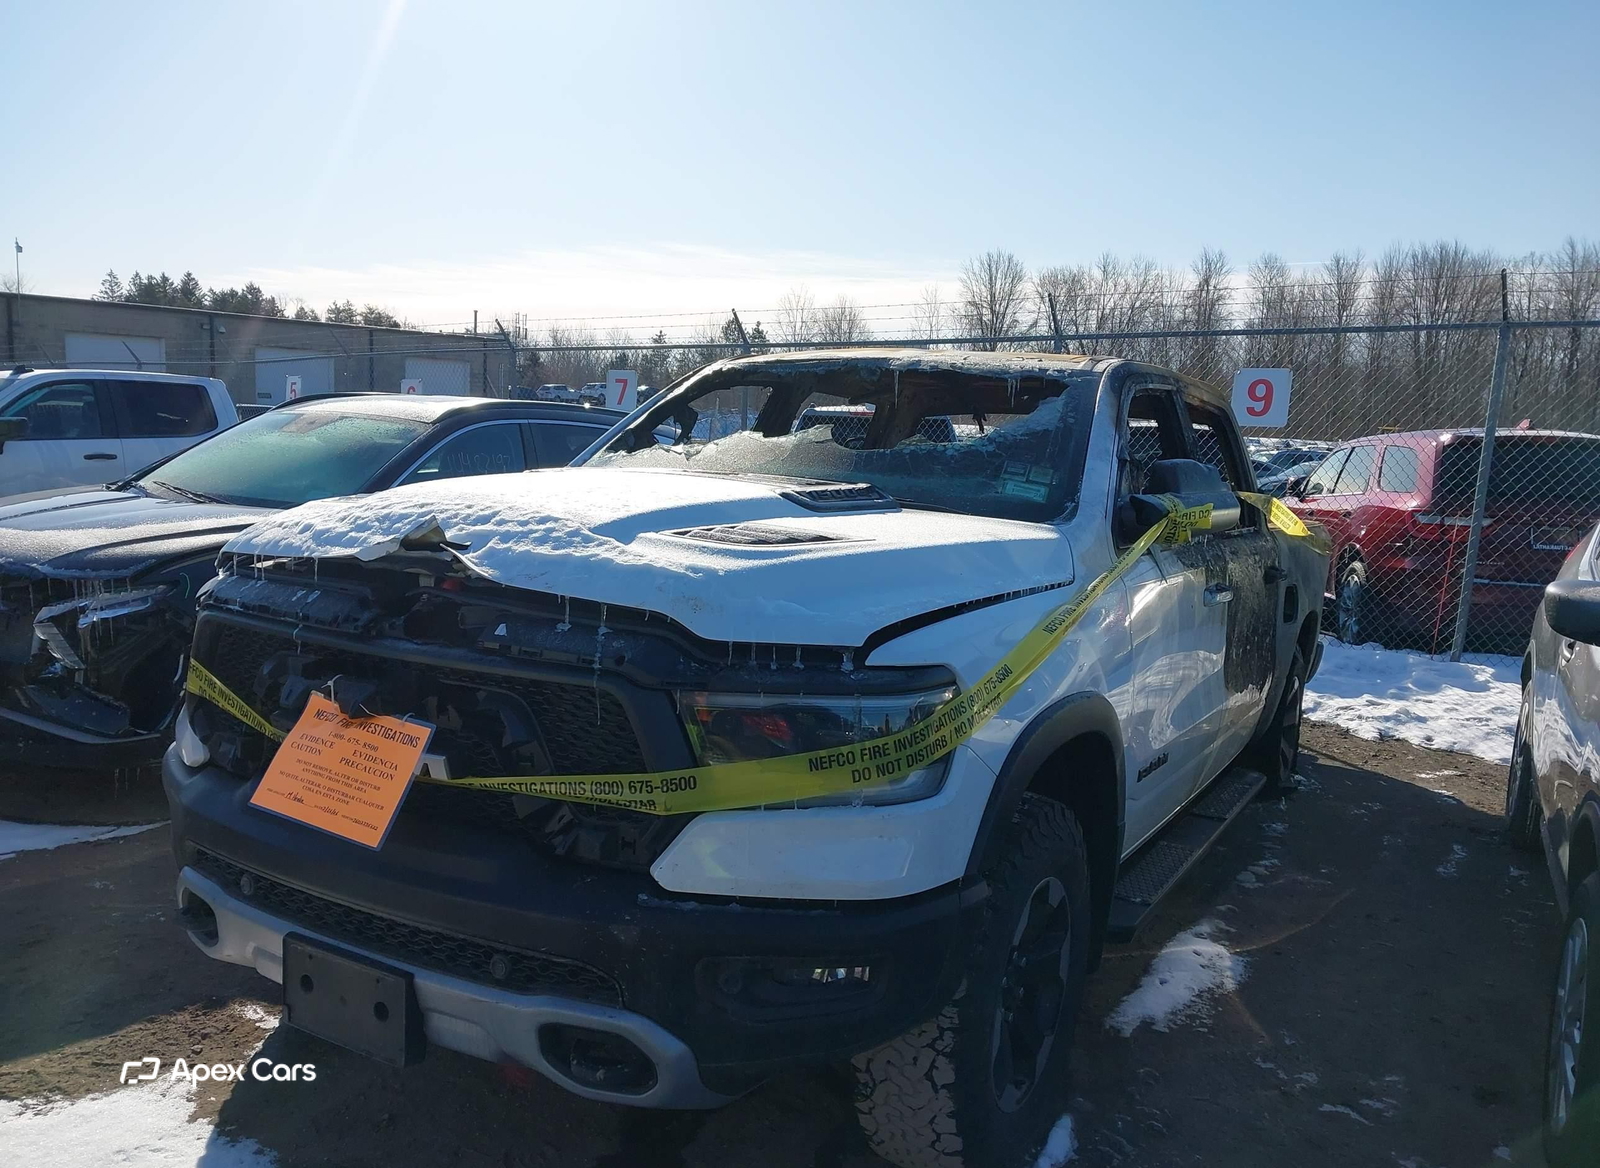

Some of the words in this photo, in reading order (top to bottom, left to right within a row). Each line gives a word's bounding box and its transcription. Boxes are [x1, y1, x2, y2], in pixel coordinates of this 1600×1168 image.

[290, 382, 297, 399] 5
[615, 378, 628, 406] 7
[1246, 378, 1274, 417] 9
[1042, 614, 1066, 635] NEFCO
[203, 674, 217, 693] FIRE
[313, 708, 339, 722] NEFCO
[337, 717, 355, 729] FIR
[356, 721, 420, 748] NVESTIGATIONS
[808, 751, 856, 772] NEFCO
[860, 742, 891, 762] FIRE
[894, 700, 968, 754] INVESTIGATIONS
[966, 686, 985, 711] (800)
[983, 663, 1013, 695] 675-8500
[291, 741, 322, 756] CAUTION
[300, 733, 336, 749] EVIDENCE
[352, 749, 398, 771] EVIDENCIA
[851, 767, 872, 784] DO
[876, 759, 903, 778] NOT
[906, 734, 948, 769] DISTURB
[954, 721, 968, 739] NO
[339, 757, 395, 781] PRECAUCION
[325, 775, 341, 784] FROM
[340, 780, 353, 788] THIS
[590, 780, 624, 797] (800)
[628, 775, 698, 795] 675-8500
